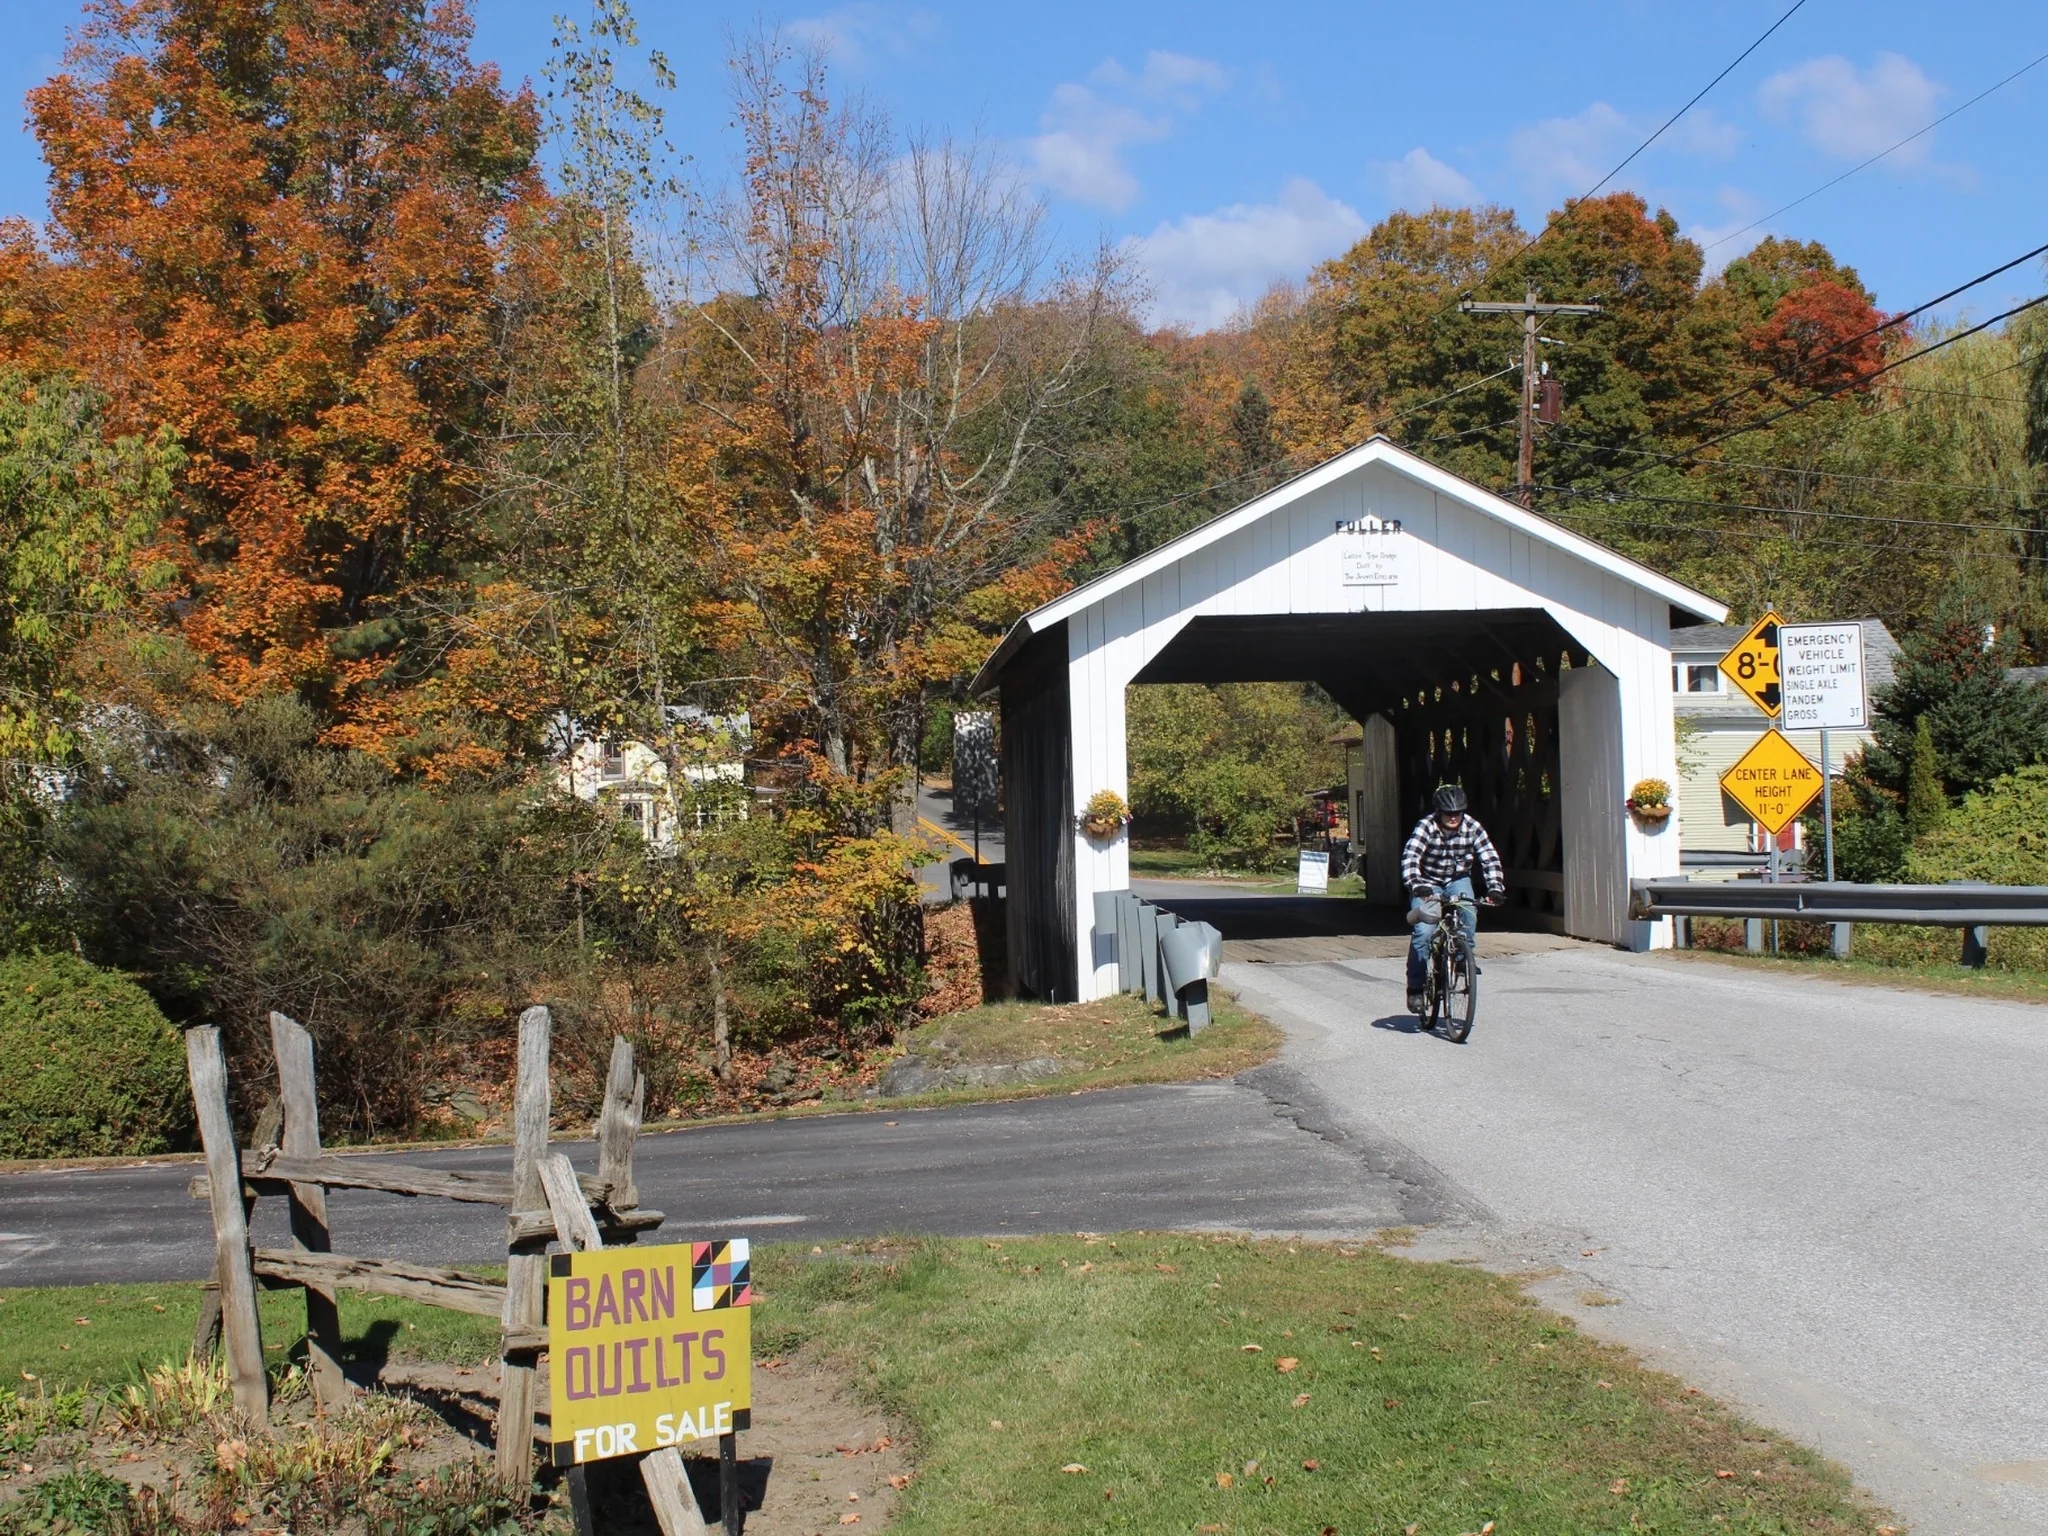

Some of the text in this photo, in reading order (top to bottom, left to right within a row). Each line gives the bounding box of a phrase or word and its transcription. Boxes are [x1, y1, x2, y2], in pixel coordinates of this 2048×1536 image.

[1335, 520, 1402, 533] FULLER
[1787, 634, 1853, 647] EMERGENCY
[1799, 649, 1845, 660] VEHICLE
[1788, 663, 1857, 676] WEIGHT LIMIT
[1786, 679, 1838, 691] SINGLE AXLE
[1786, 694, 1824, 705] TANDEM
[1787, 707, 1860, 720] GROSS 3T
[1735, 768, 1812, 781] CENTER LANE
[1755, 786, 1793, 798] HEIGHT
[565, 1265, 675, 1331] BARN
[565, 1329, 726, 1401] QUILTS
[574, 1401, 734, 1462] FOR SALE
